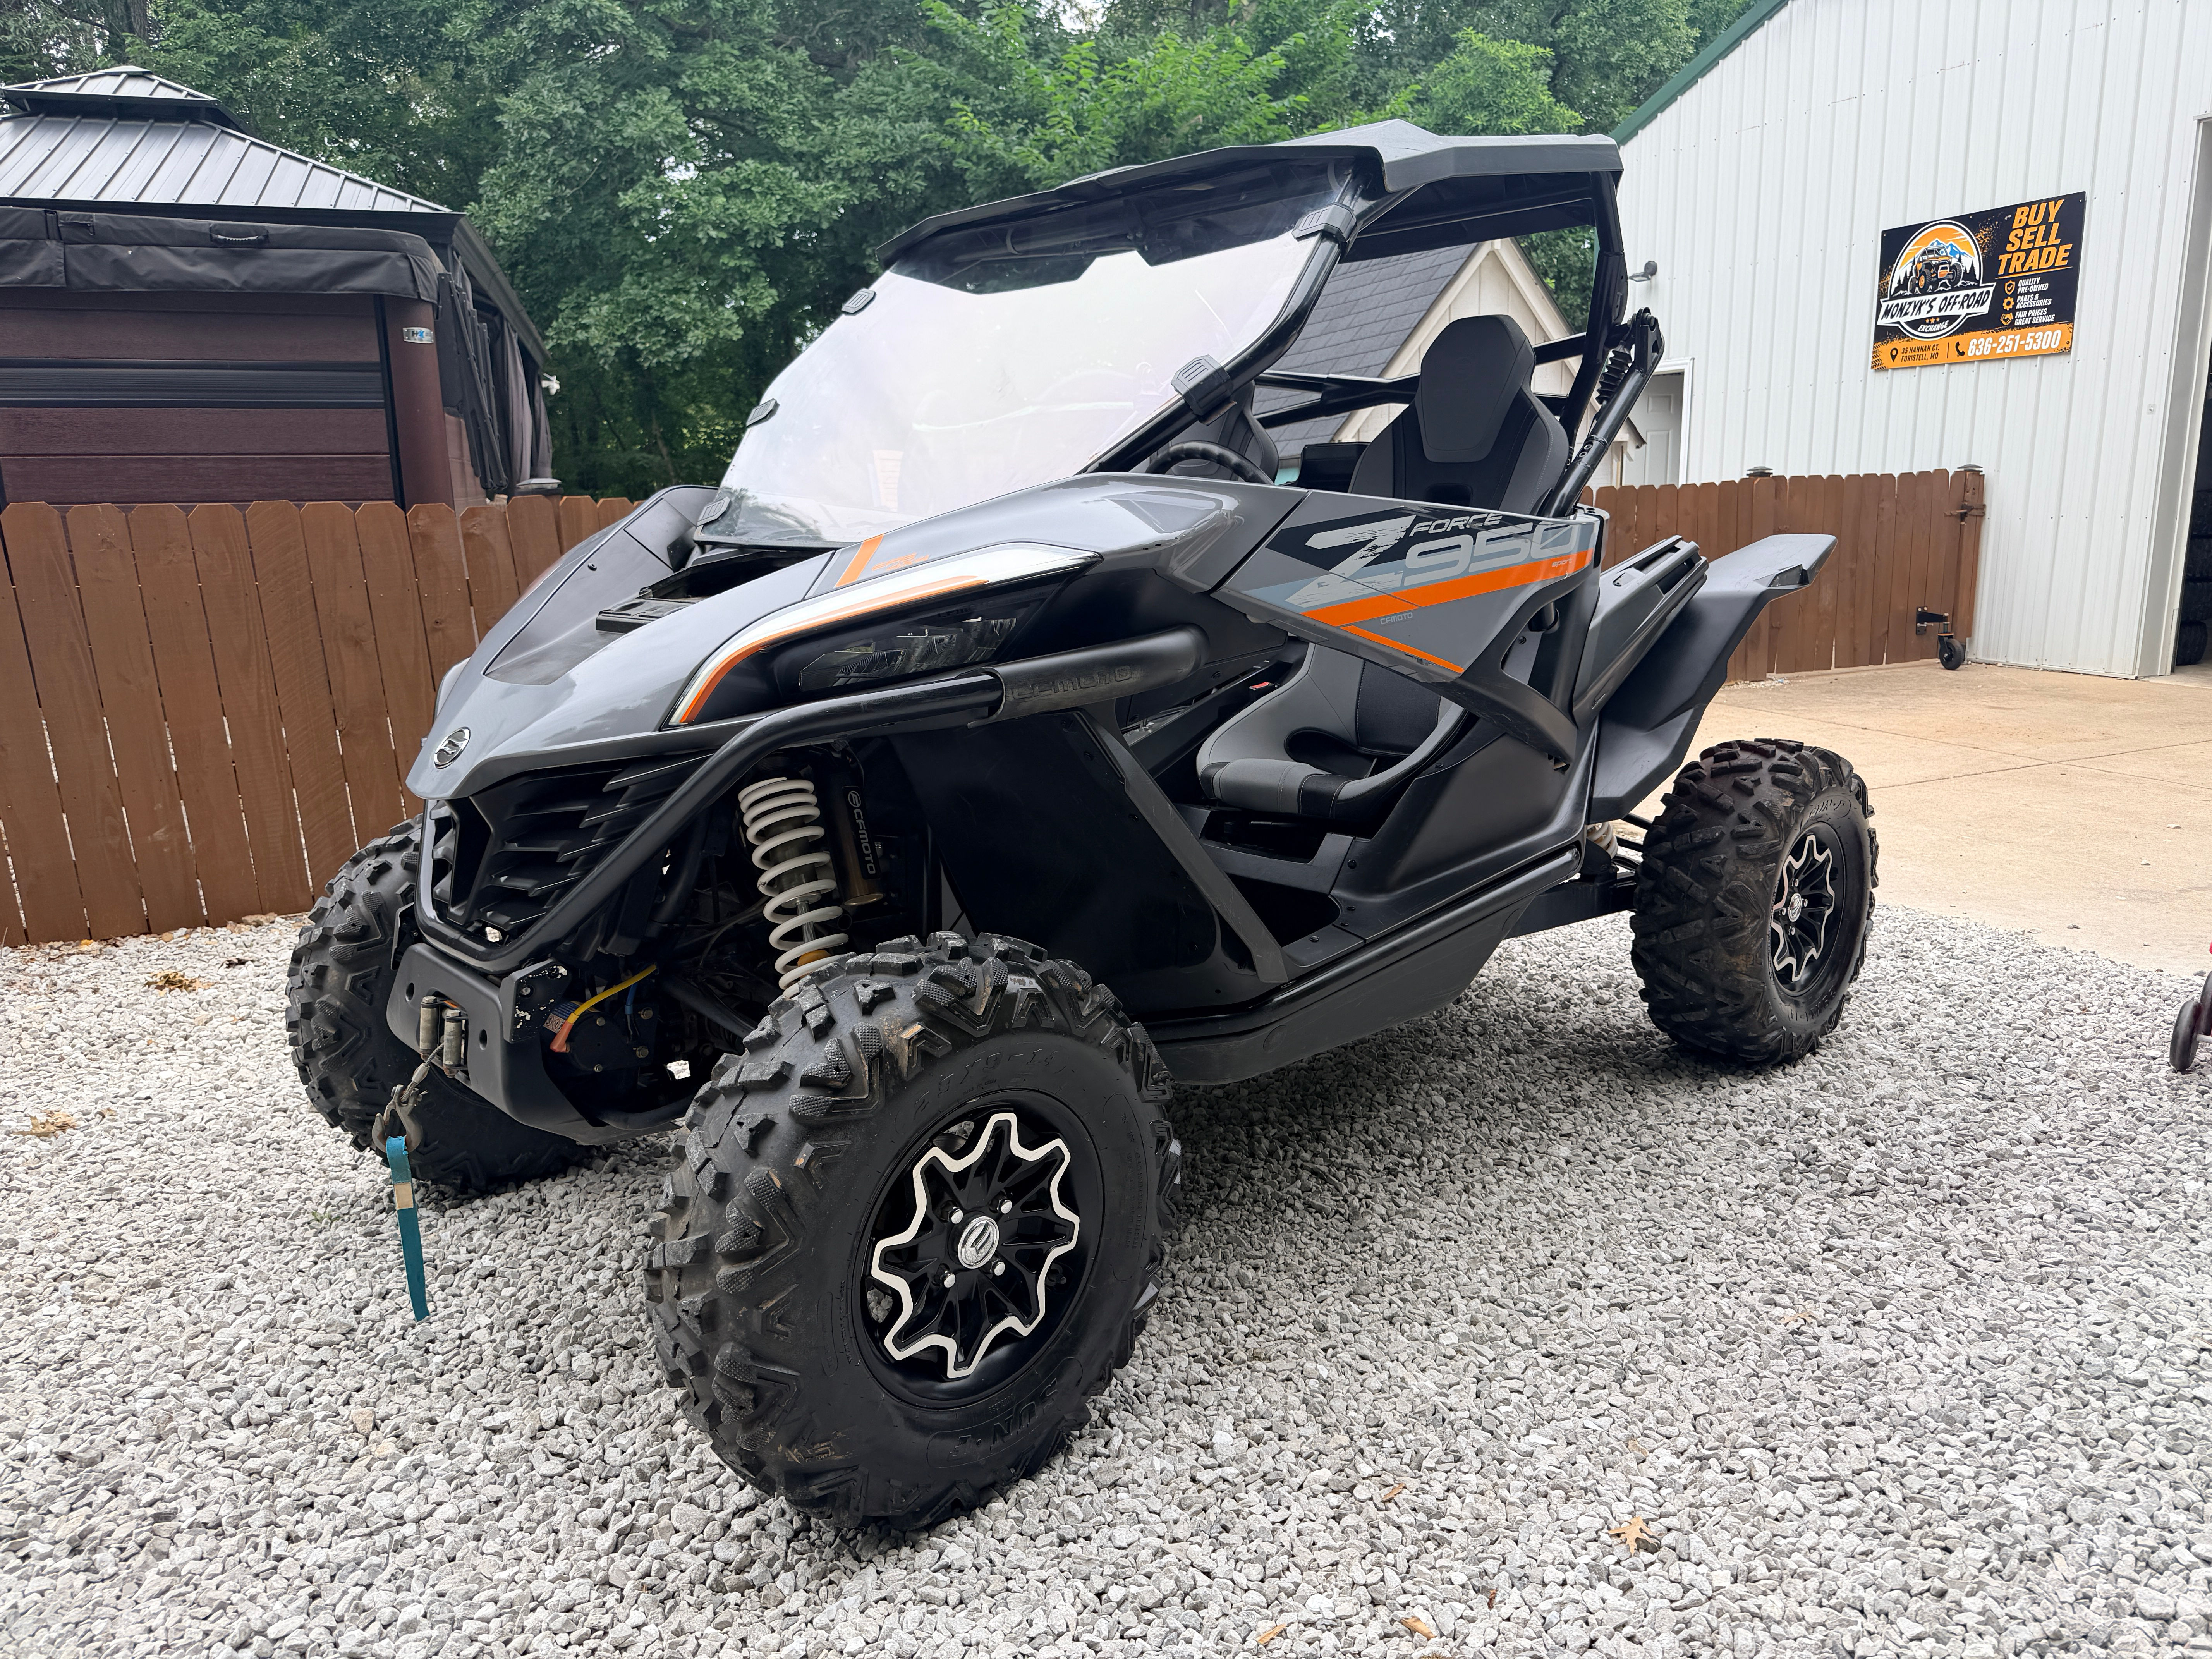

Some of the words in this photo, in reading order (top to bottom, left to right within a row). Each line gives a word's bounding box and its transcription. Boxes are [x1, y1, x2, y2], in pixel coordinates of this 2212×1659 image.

[2013, 199, 2064, 228] BUY
[2006, 222, 2061, 252] SELL
[1998, 244, 2072, 275] TRADE
[2017, 283, 2049, 294] PRE-OWNED
[2018, 277, 2041, 287] QUALITY
[1882, 297, 1937, 319] MONZYK'S
[1939, 290, 1990, 313] OFF-ROAD
[2016, 294, 2034, 303] PARTS
[2016, 298, 2052, 309] ACCESSORIES
[2014, 317, 2032, 326] GREAT
[2032, 314, 2055, 324] SERVICE
[2015, 311, 2027, 319] FAIR
[2028, 308, 2047, 317] PRICES
[1917, 321, 1949, 332] EXCHANGE
[1909, 345, 1930, 353] HANNAH
[1968, 330, 2061, 356] 636-251-5300
[1900, 353, 1928, 362] FORISTELL,
[1409, 513, 1503, 537] FORCE
[1403, 520, 1578, 586] 950
[1380, 612, 1413, 625] CFMOTO
[853, 809, 877, 874] CFMOTO
